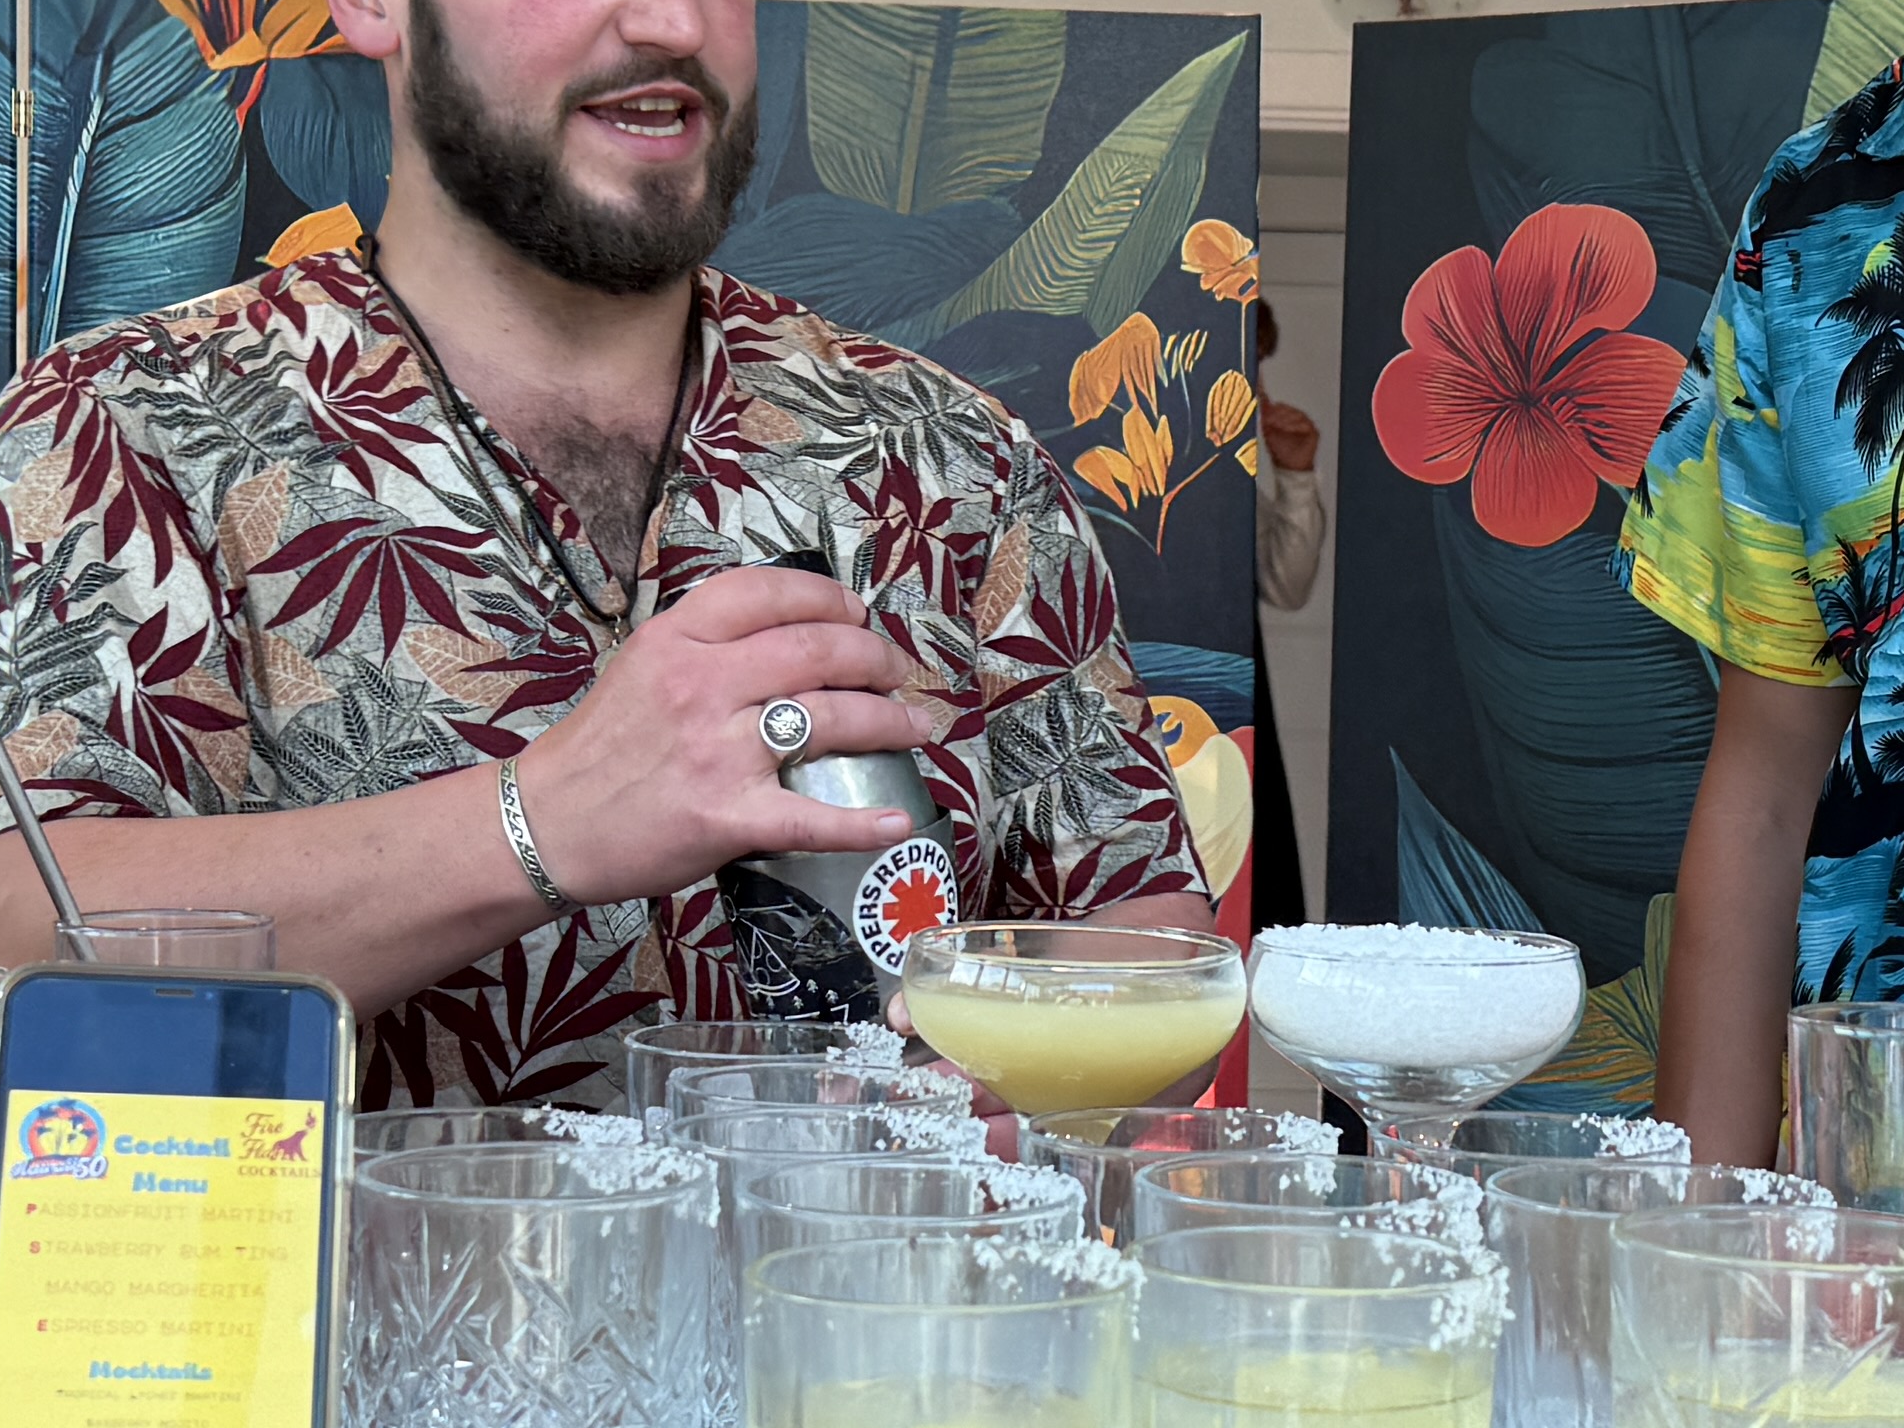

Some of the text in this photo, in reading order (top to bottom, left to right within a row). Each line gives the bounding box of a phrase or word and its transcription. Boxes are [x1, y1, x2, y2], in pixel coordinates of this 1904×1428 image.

[873, 843, 953, 886] RED HOT
[858, 884, 904, 968] PPERS
[240, 1112, 284, 1138] Fire
[113, 1134, 231, 1158] Cocktail
[74, 1154, 107, 1179] 50
[237, 1165, 322, 1179] COCKTAILS
[132, 1171, 208, 1194] Menu
[25, 1202, 295, 1224] PASSIONFRUIT MARTINI
[28, 1239, 166, 1258] STRAWBERRY
[44, 1279, 116, 1296] MANGO
[36, 1317, 256, 1338] ESPRESSO MARTINI
[89, 1360, 214, 1381] Mocktails
